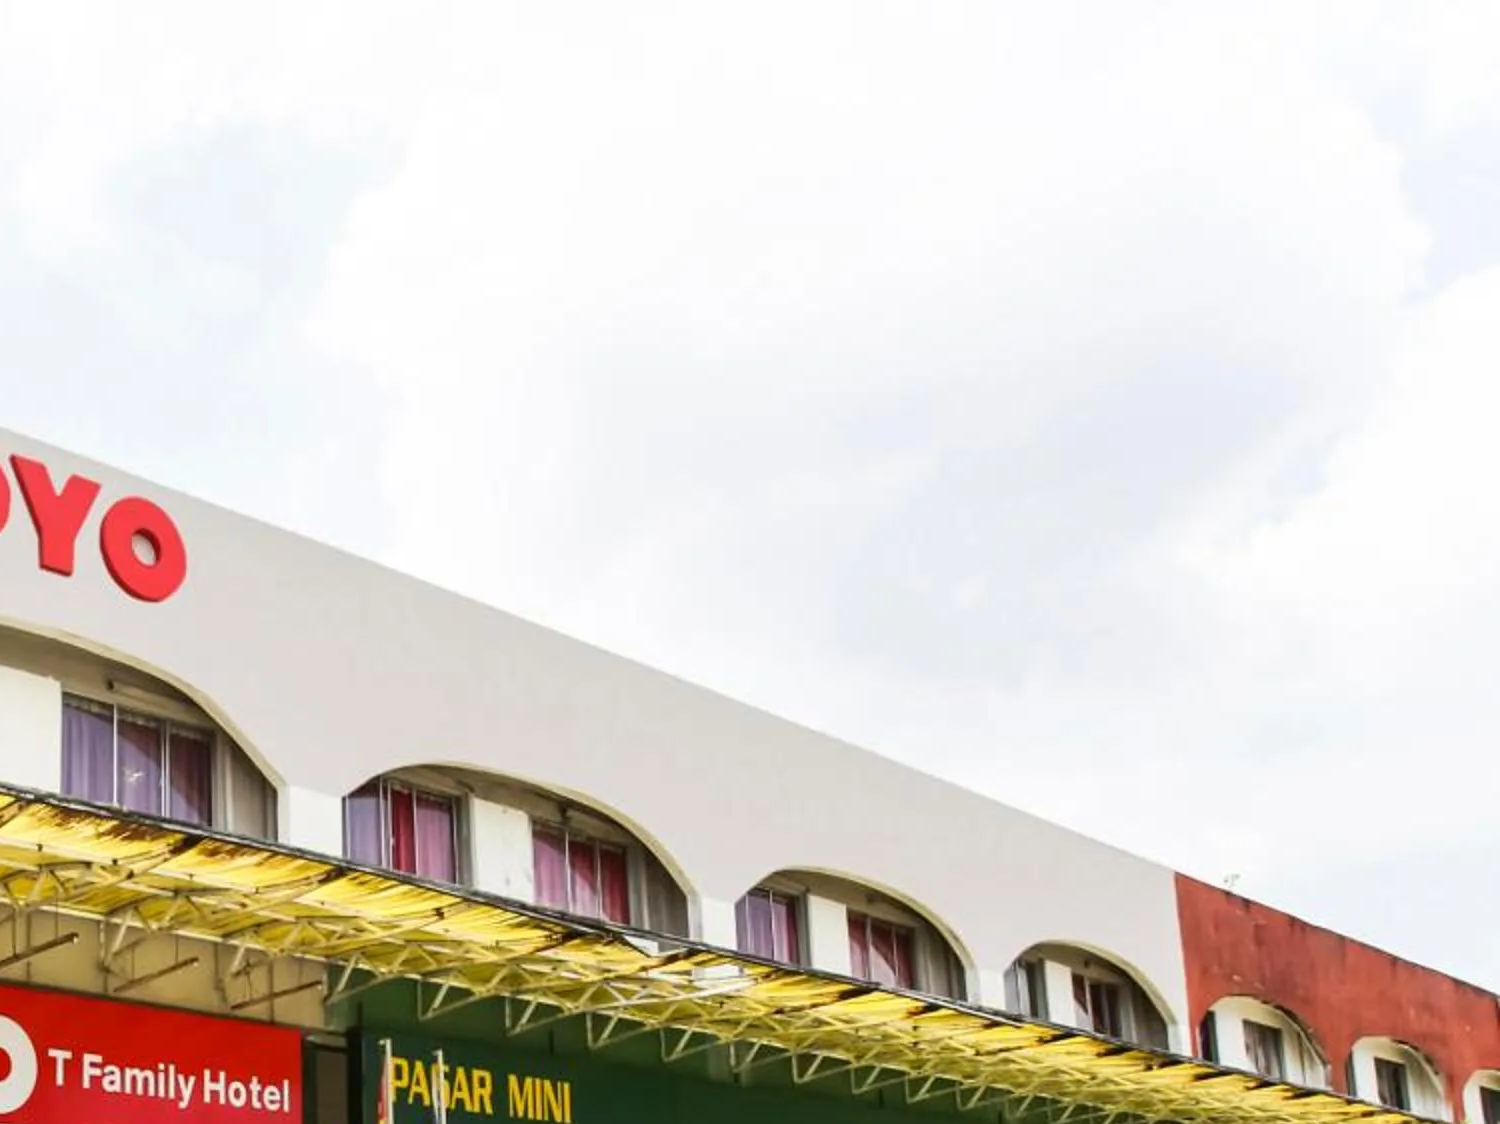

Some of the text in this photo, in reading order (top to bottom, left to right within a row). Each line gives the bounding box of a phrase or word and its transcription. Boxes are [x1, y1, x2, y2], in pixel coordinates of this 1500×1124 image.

[48, 1048, 73, 1087] T
[82, 1053, 196, 1109] Family
[203, 1069, 290, 1113] Hotel
[508, 1074, 571, 1124] MINI
